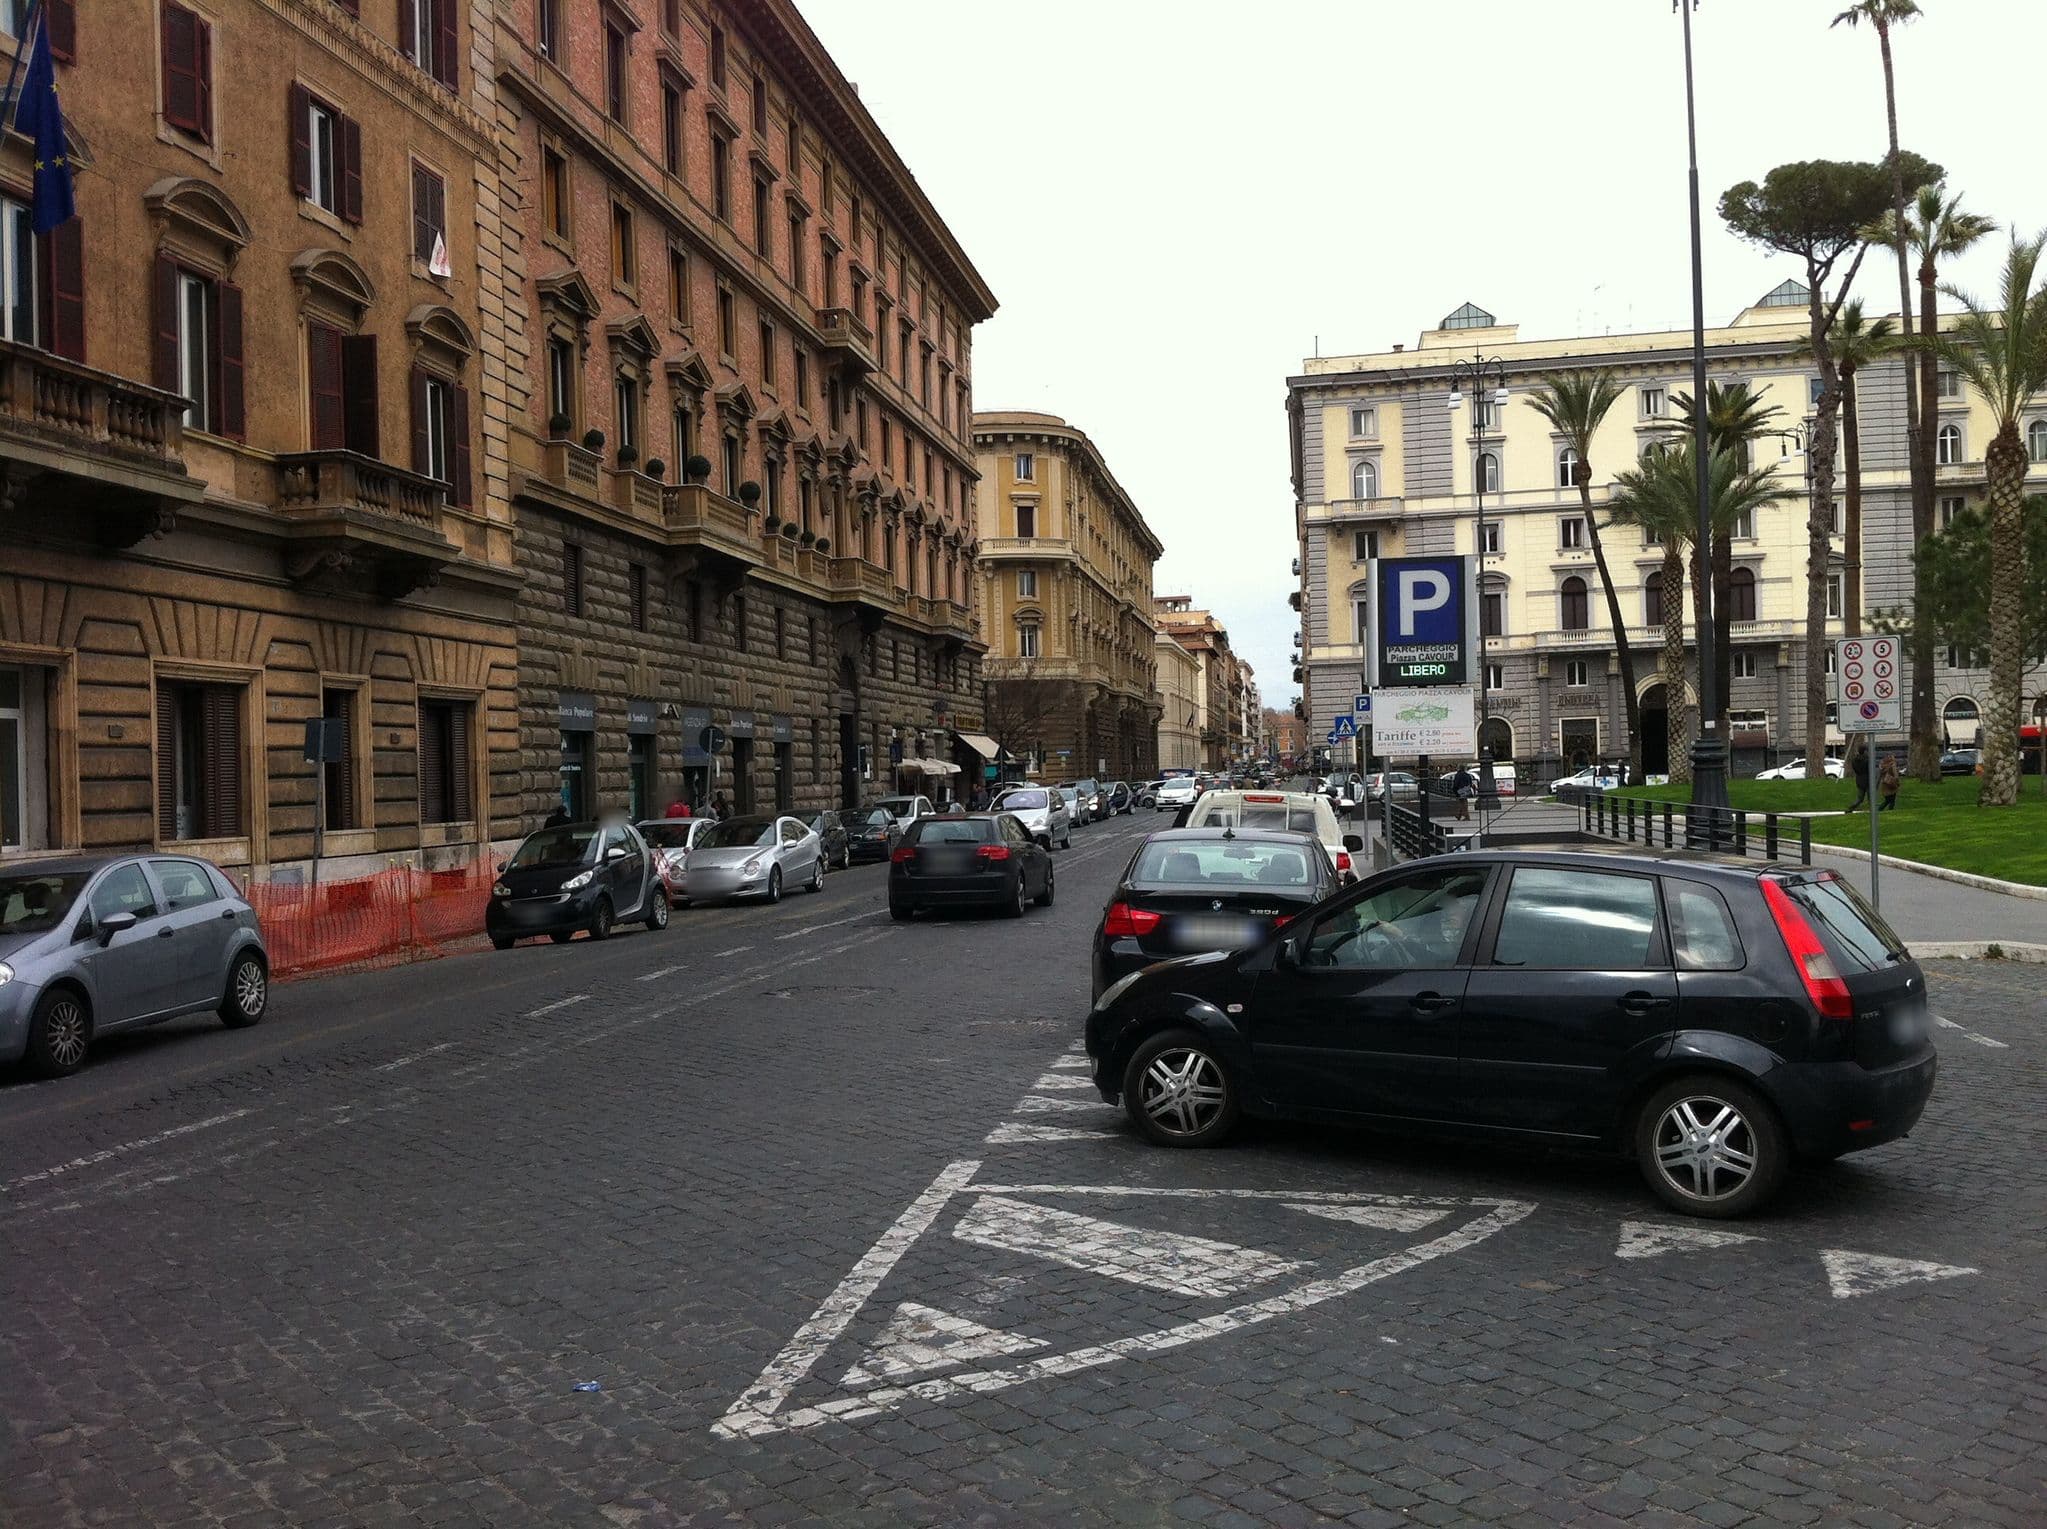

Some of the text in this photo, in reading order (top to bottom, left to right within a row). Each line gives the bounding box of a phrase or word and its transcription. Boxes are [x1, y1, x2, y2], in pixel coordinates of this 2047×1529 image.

[1399, 569, 1451, 636] P
[1388, 644, 1457, 654] PARCHEGGIO
[1879, 644, 1886, 654] 5
[1390, 651, 1455, 663] Piazza CAVOUR
[1400, 664, 1446, 677] LIBERO
[1374, 688, 1472, 698] PARCHEGGIO PIAZZA CAVOUR
[1359, 698, 1368, 710] P
[1375, 729, 1417, 742] Tariffe
